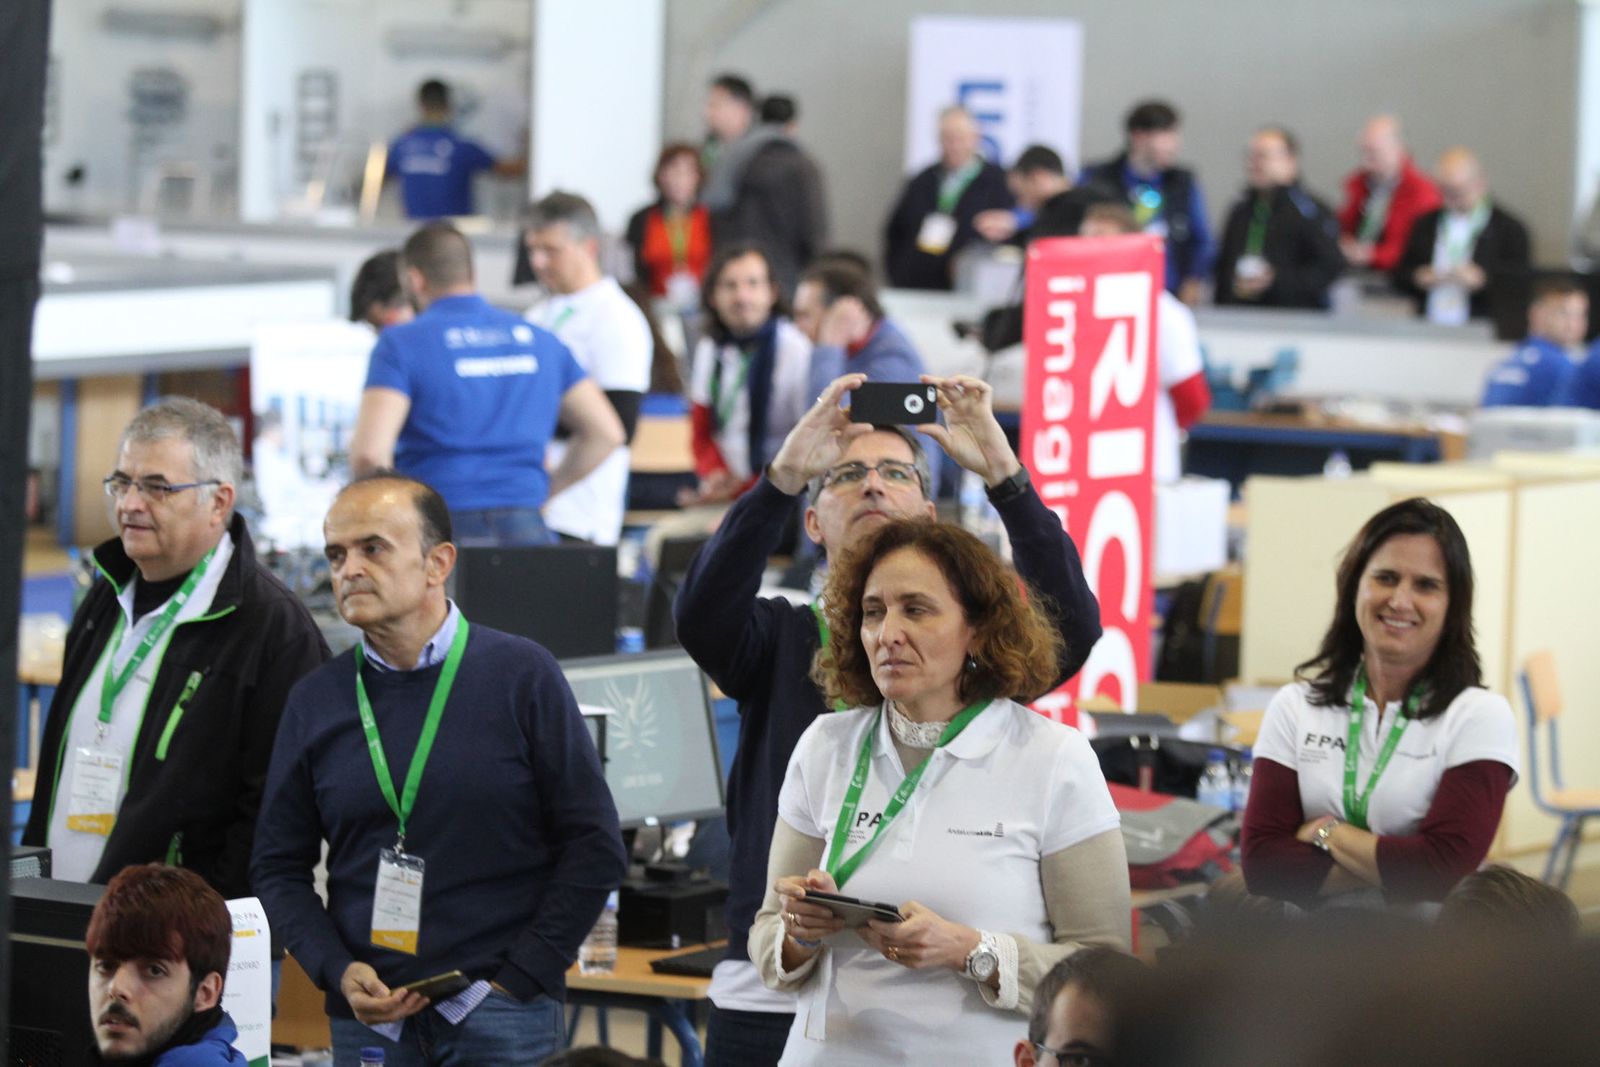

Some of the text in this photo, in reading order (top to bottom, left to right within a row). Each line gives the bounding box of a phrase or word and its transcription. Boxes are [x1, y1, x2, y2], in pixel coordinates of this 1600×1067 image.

[1033, 275, 1086, 535] imagi
[1078, 271, 1152, 739] RICO
[1304, 733, 1347, 752] FPA
[856, 812, 883, 828] PA
